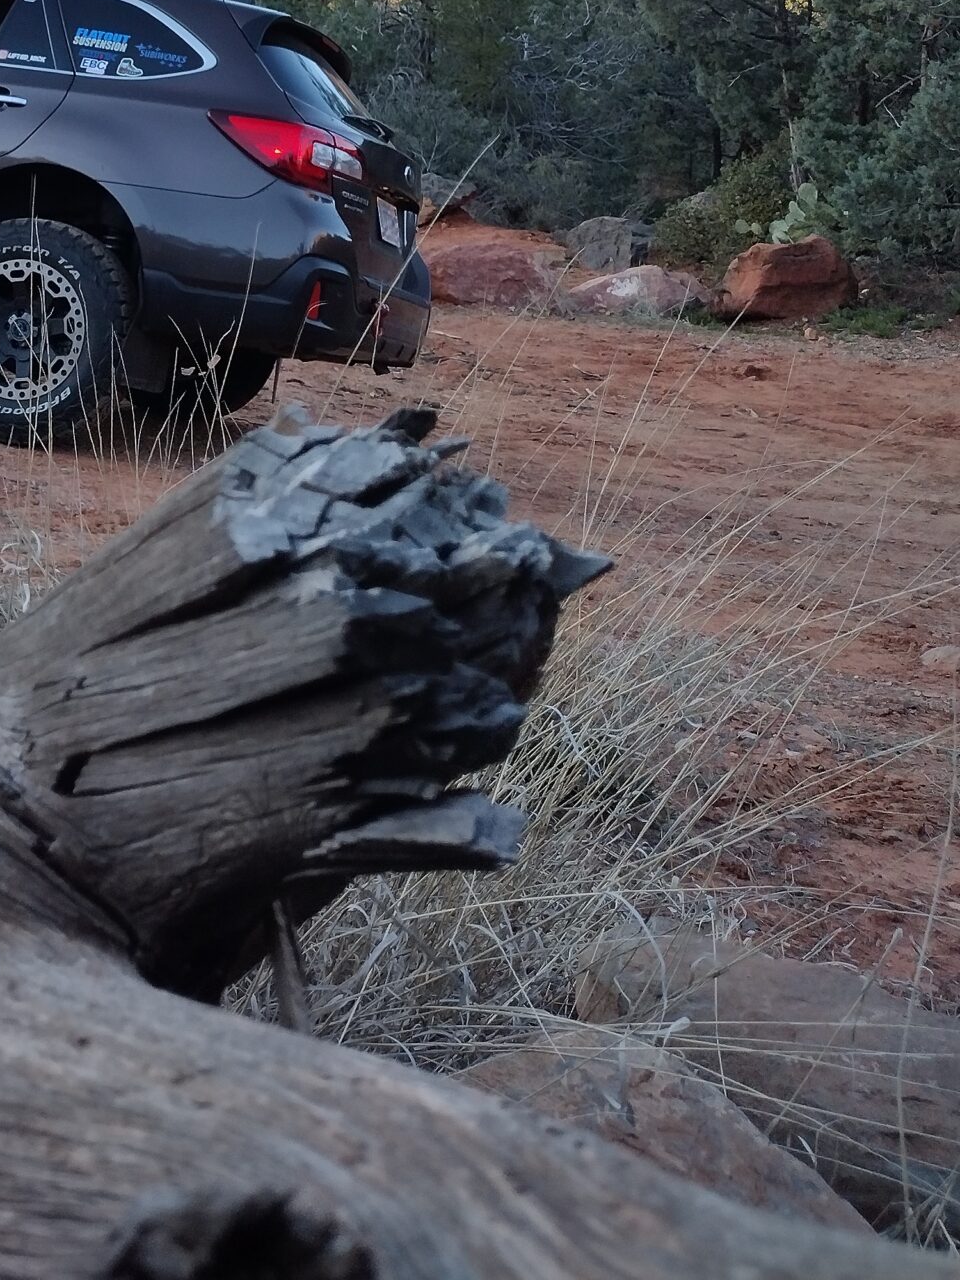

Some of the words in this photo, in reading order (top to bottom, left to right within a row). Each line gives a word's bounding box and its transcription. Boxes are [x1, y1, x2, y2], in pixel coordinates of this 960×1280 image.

[73, 36, 128, 53] SUSPENSION
[82, 58, 106, 70] EBC
[56, 255, 82, 280] T/A
